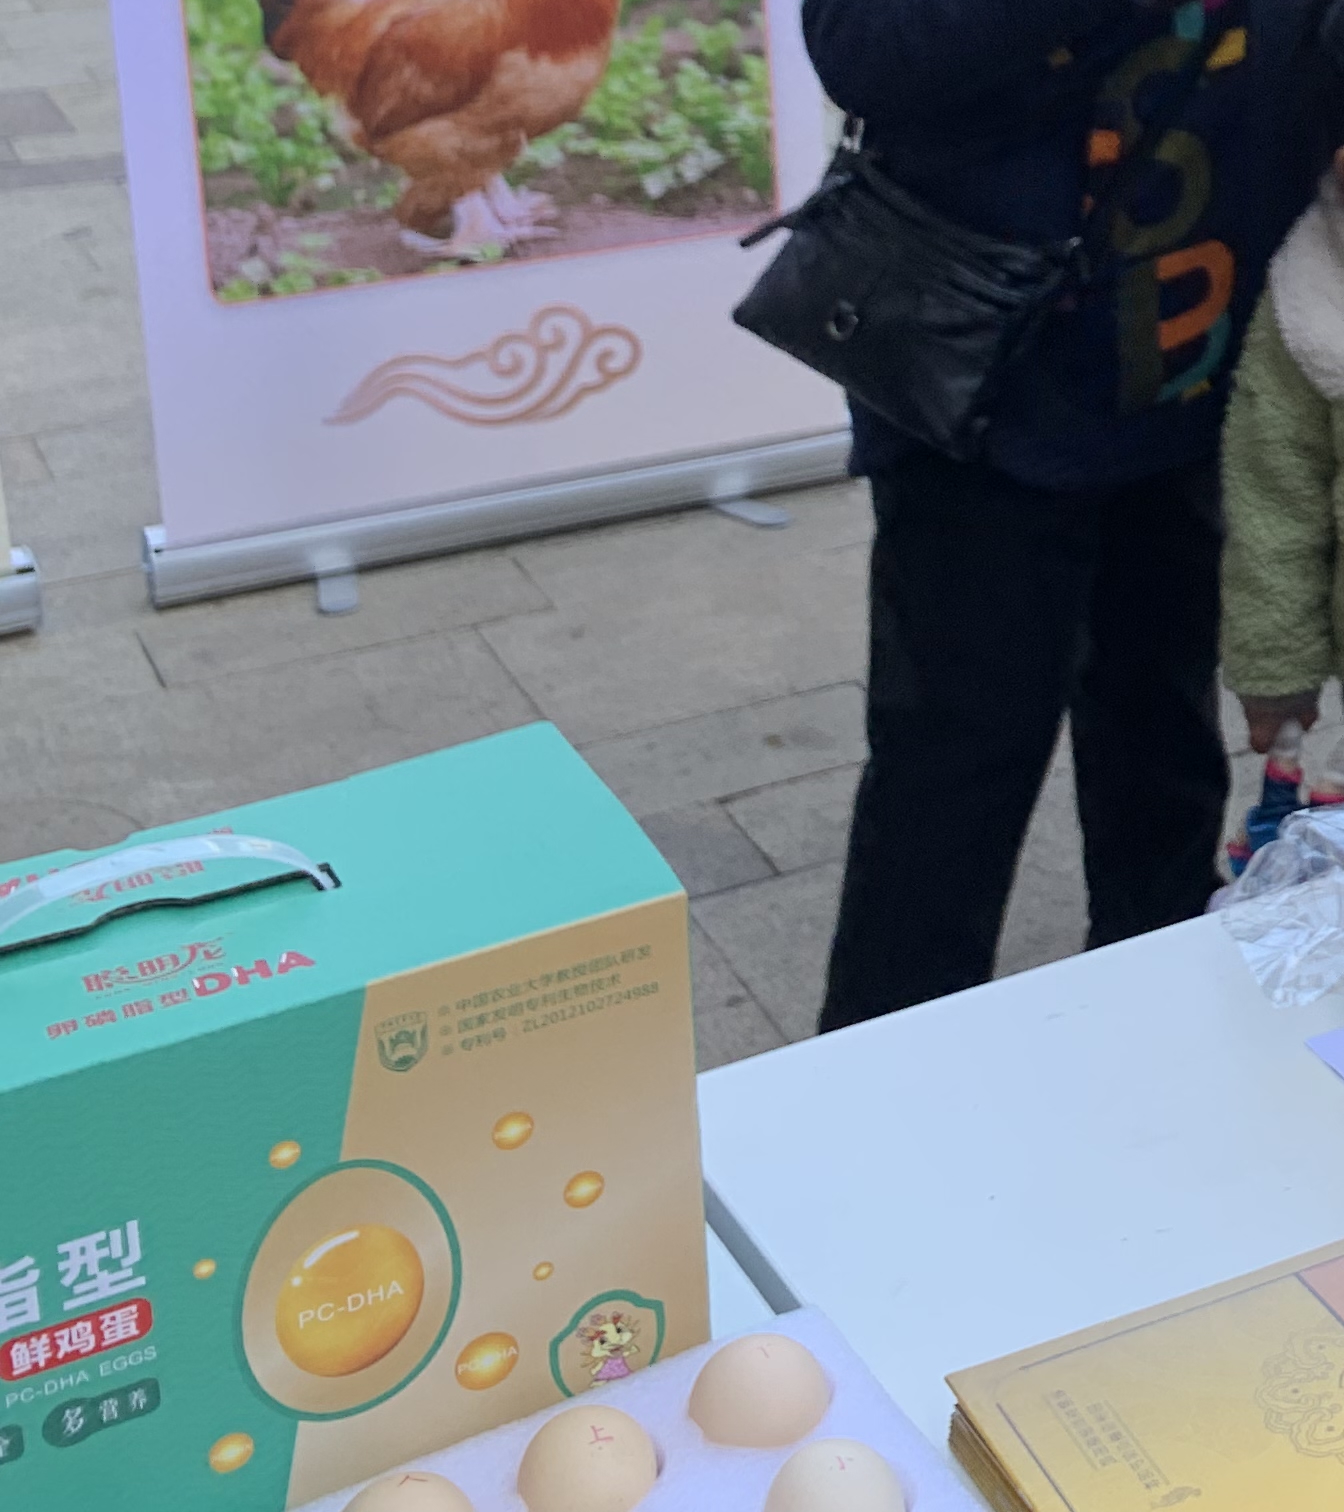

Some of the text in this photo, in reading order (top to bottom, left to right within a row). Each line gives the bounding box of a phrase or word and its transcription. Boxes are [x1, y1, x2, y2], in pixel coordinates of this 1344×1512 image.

[297, 1279, 406, 1331] PC-DHA
[10, 1303, 140, 1377] 鲜鸡蛋
[5, 1345, 158, 1408] PC-DHA EGGS
